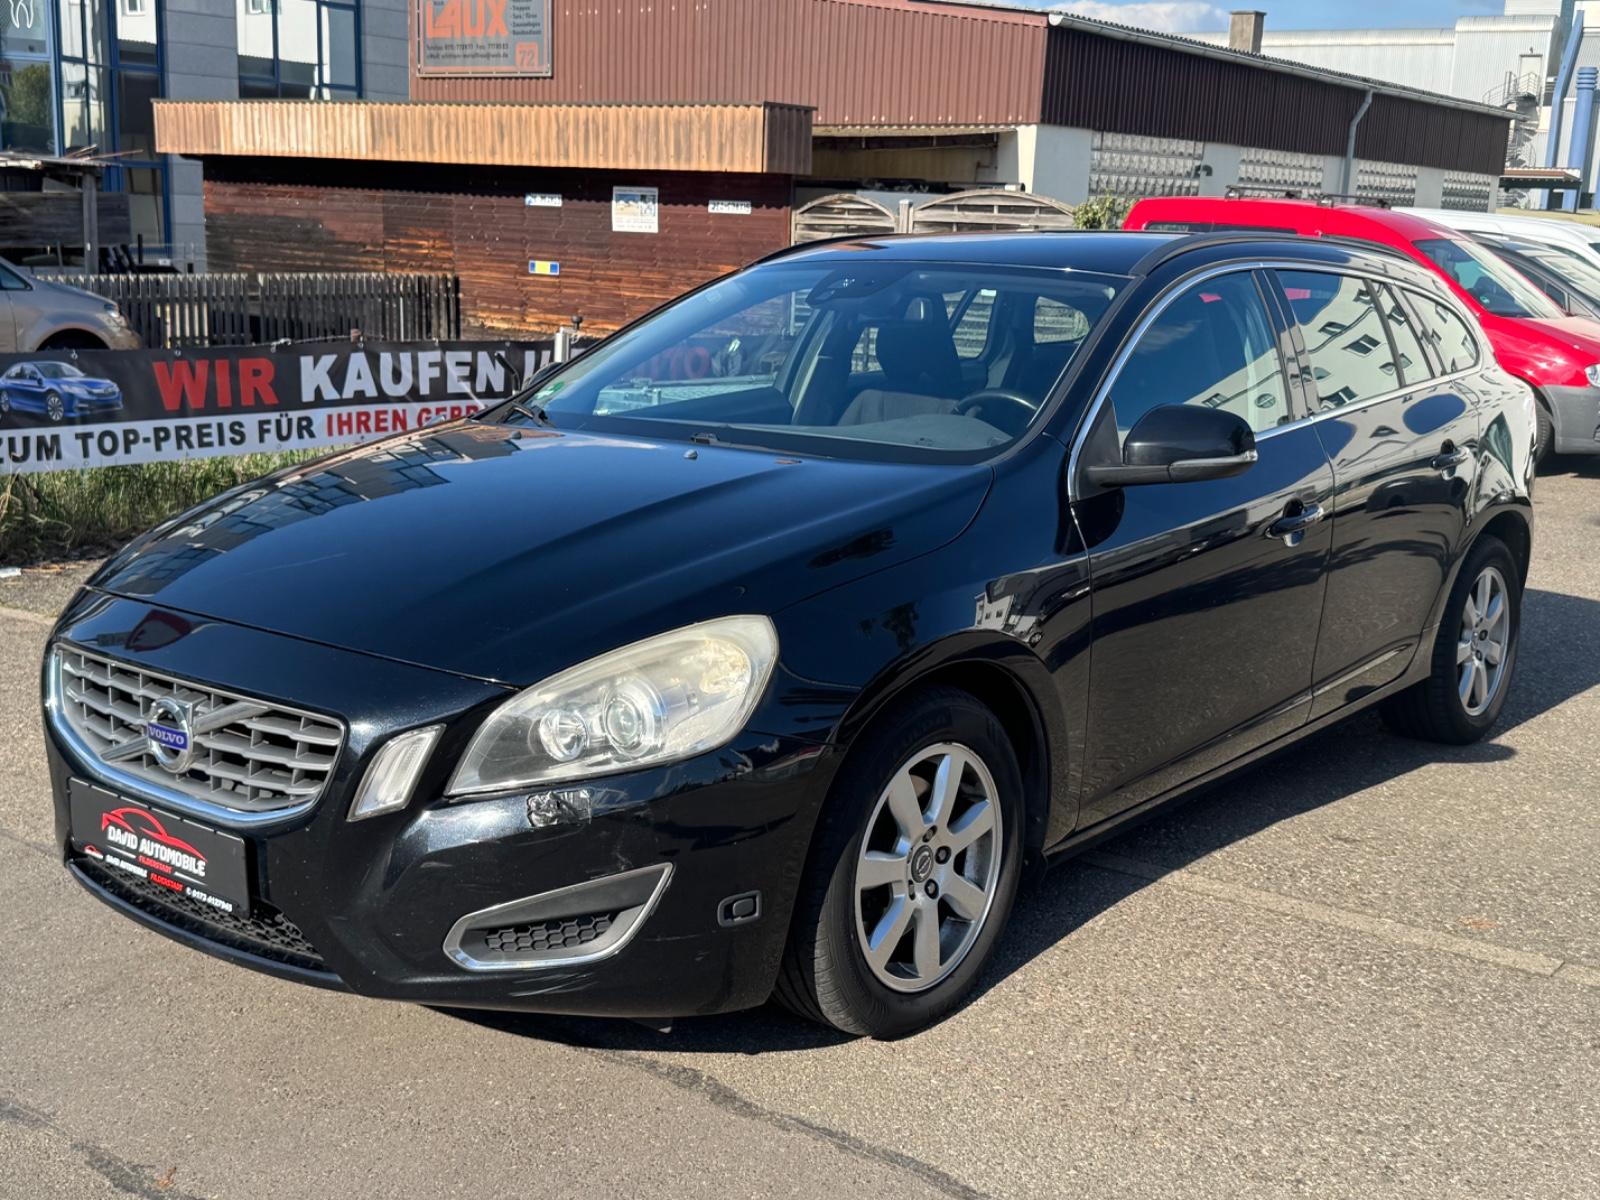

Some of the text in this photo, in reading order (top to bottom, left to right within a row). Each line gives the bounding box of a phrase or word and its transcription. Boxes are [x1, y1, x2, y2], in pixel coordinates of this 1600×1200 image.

[153, 357, 278, 411] WIR
[301, 350, 505, 402] KAUFEN
[0, 434, 62, 464] UM
[75, 420, 246, 458] TOP-PREIS
[258, 413, 316, 443] FÜR
[327, 408, 408, 437] IHREN
[149, 726, 185, 745] VOLVO
[107, 825, 206, 877] DAVID AUTOMOBILE
